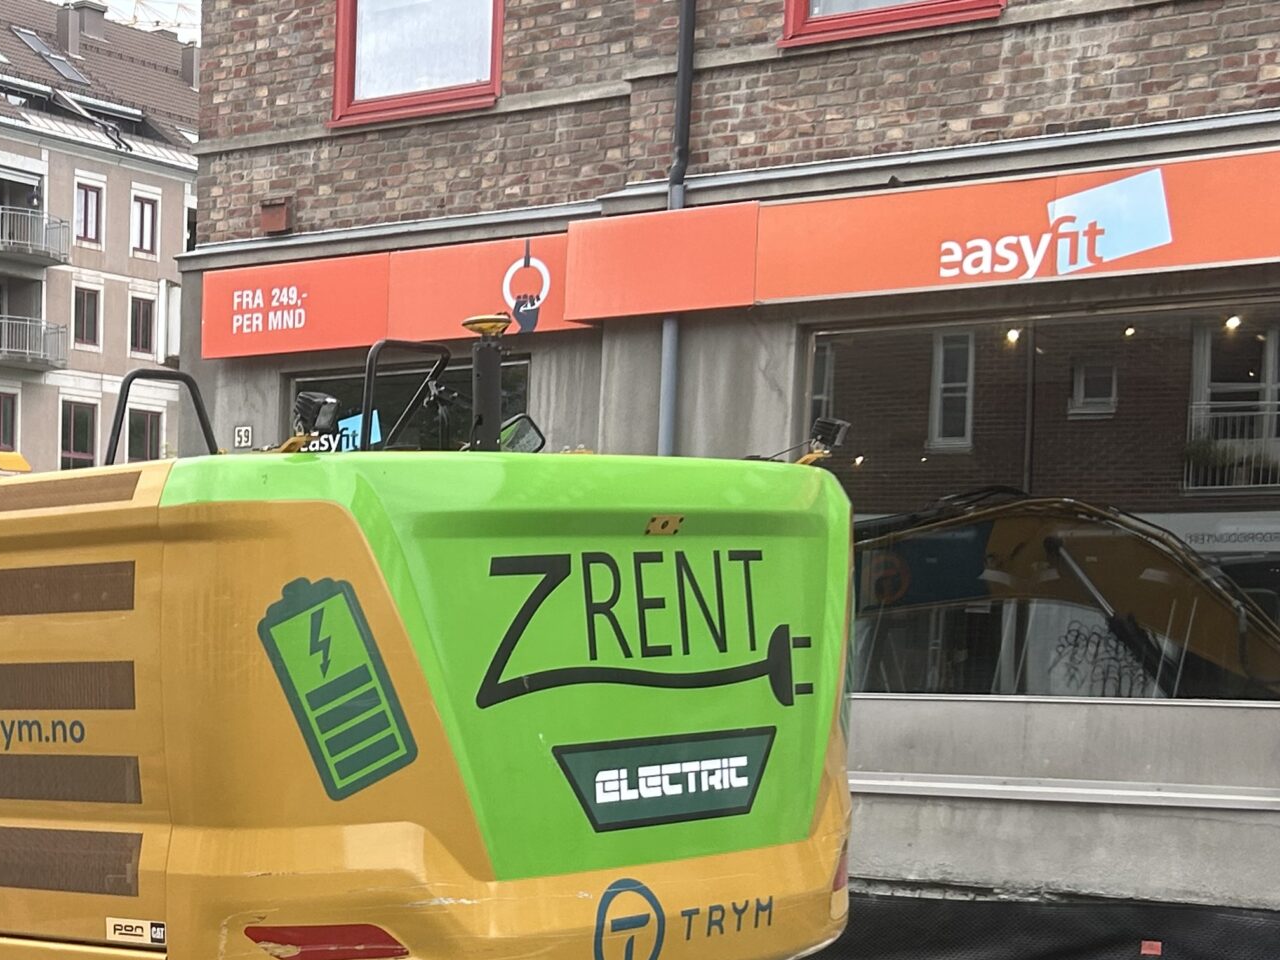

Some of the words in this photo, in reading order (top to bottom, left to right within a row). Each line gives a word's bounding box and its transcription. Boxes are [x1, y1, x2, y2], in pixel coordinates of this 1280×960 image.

[939, 215, 1106, 280] easyfit
[232, 288, 264, 311] FRA
[271, 285, 308, 307] 249,-
[232, 312, 263, 335] PER
[268, 308, 305, 331] MND
[236, 427, 250, 445] 59
[476, 550, 763, 709] ZRENT
[596, 756, 749, 803] ELECTRIC
[681, 896, 773, 941] TRYM
